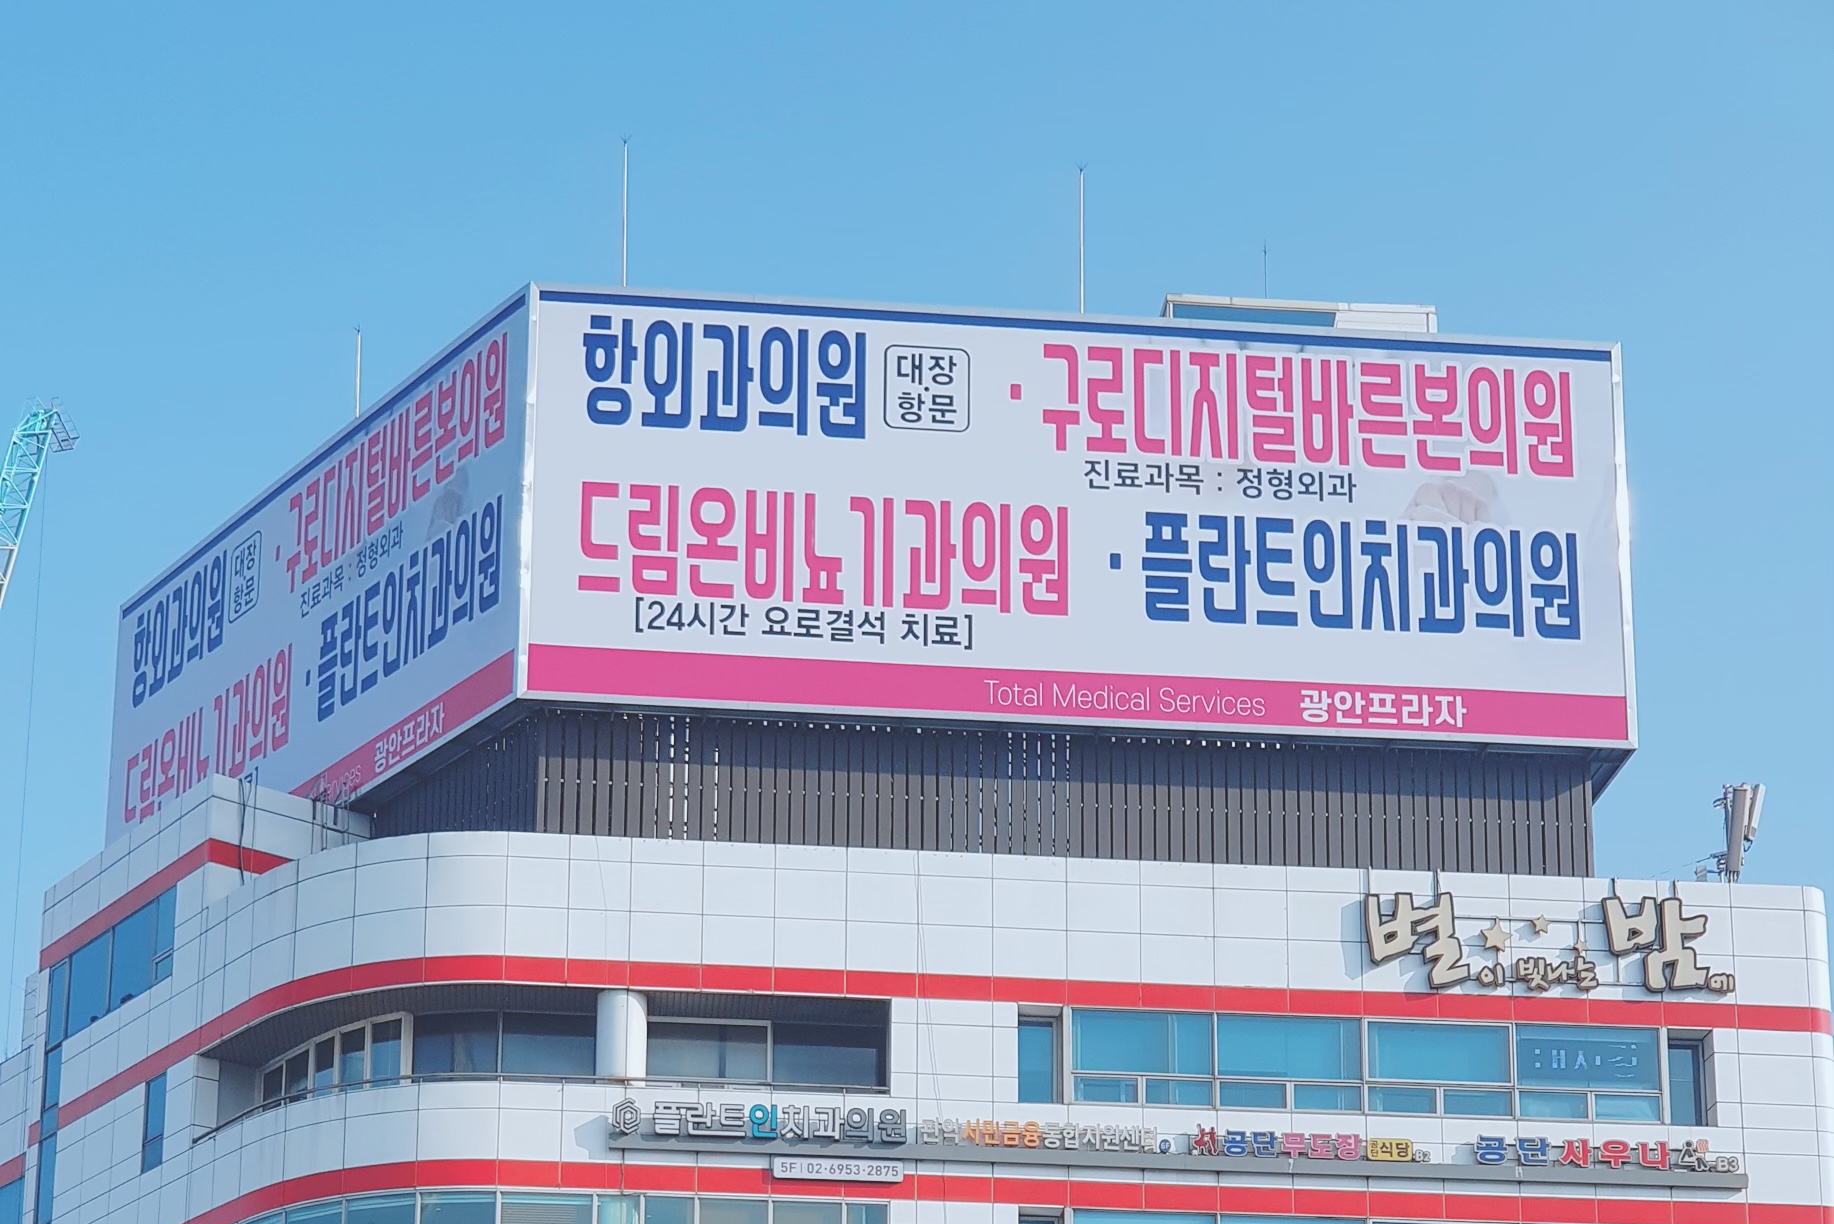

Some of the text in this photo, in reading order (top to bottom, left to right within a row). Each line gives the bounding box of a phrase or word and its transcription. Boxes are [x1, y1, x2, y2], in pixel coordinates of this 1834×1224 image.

[583, 314, 866, 439] 항외과의원
[896, 352, 958, 386] 대장
[897, 392, 958, 424] 항문
[1042, 344, 1575, 478] 구로디지털바른본의원
[286, 332, 508, 593] 구로디지털바른본의원
[1083, 459, 1204, 494] 진료과목
[1235, 467, 1358, 503] 정형외과
[234, 540, 258, 577] 대장
[300, 573, 346, 618] 진료과목
[355, 522, 404, 576] 정형외과
[577, 481, 1070, 616] 드림온비뇨기과의원
[233, 574, 255, 613] 항문
[1142, 511, 1582, 641] 플란트인치과의원
[132, 549, 228, 709] 항외과의원
[317, 495, 503, 723] 플란트인치과의원
[761, 606, 887, 645] 요로결석
[984, 680, 1266, 717] Total Medical Services
[1300, 688, 1467, 729] 광안프라자
[374, 701, 446, 773] 광안프라자
[653, 1101, 907, 1144] 플란트인치과의원
[780, 1161, 797, 1174] 5F
[1380, 1140, 1410, 1159] 식당
